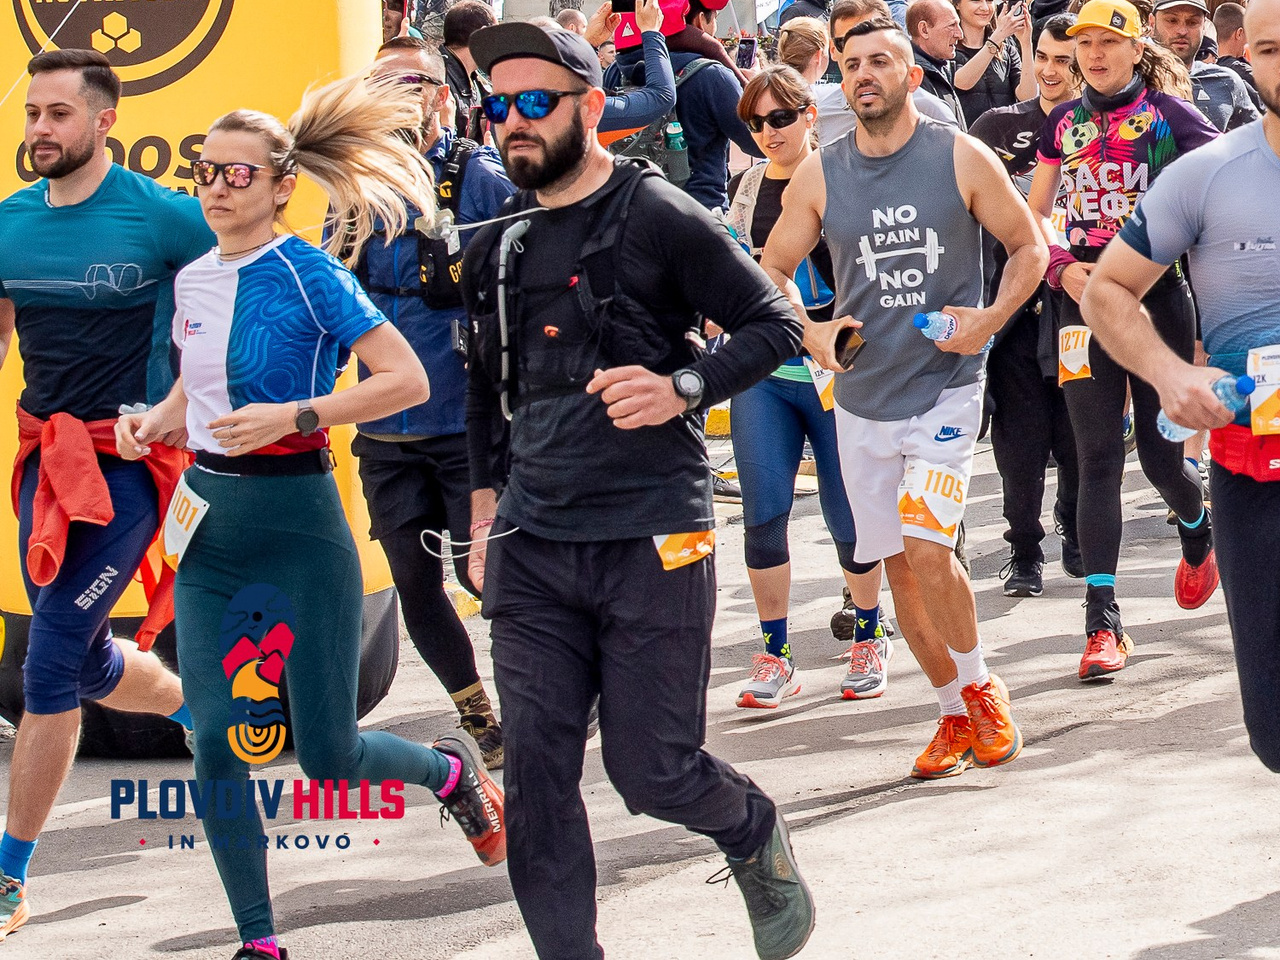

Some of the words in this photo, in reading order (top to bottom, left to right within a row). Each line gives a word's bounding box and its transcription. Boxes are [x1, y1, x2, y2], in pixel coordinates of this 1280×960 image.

[872, 204, 918, 228] NO
[1065, 191, 1145, 222] КЕФ
[873, 227, 920, 247] PAIN
[879, 268, 924, 290] NO
[880, 291, 926, 308] GAIN
[1060, 330, 1087, 354] 1271
[939, 425, 963, 436] NIKE
[924, 469, 964, 504] 1105
